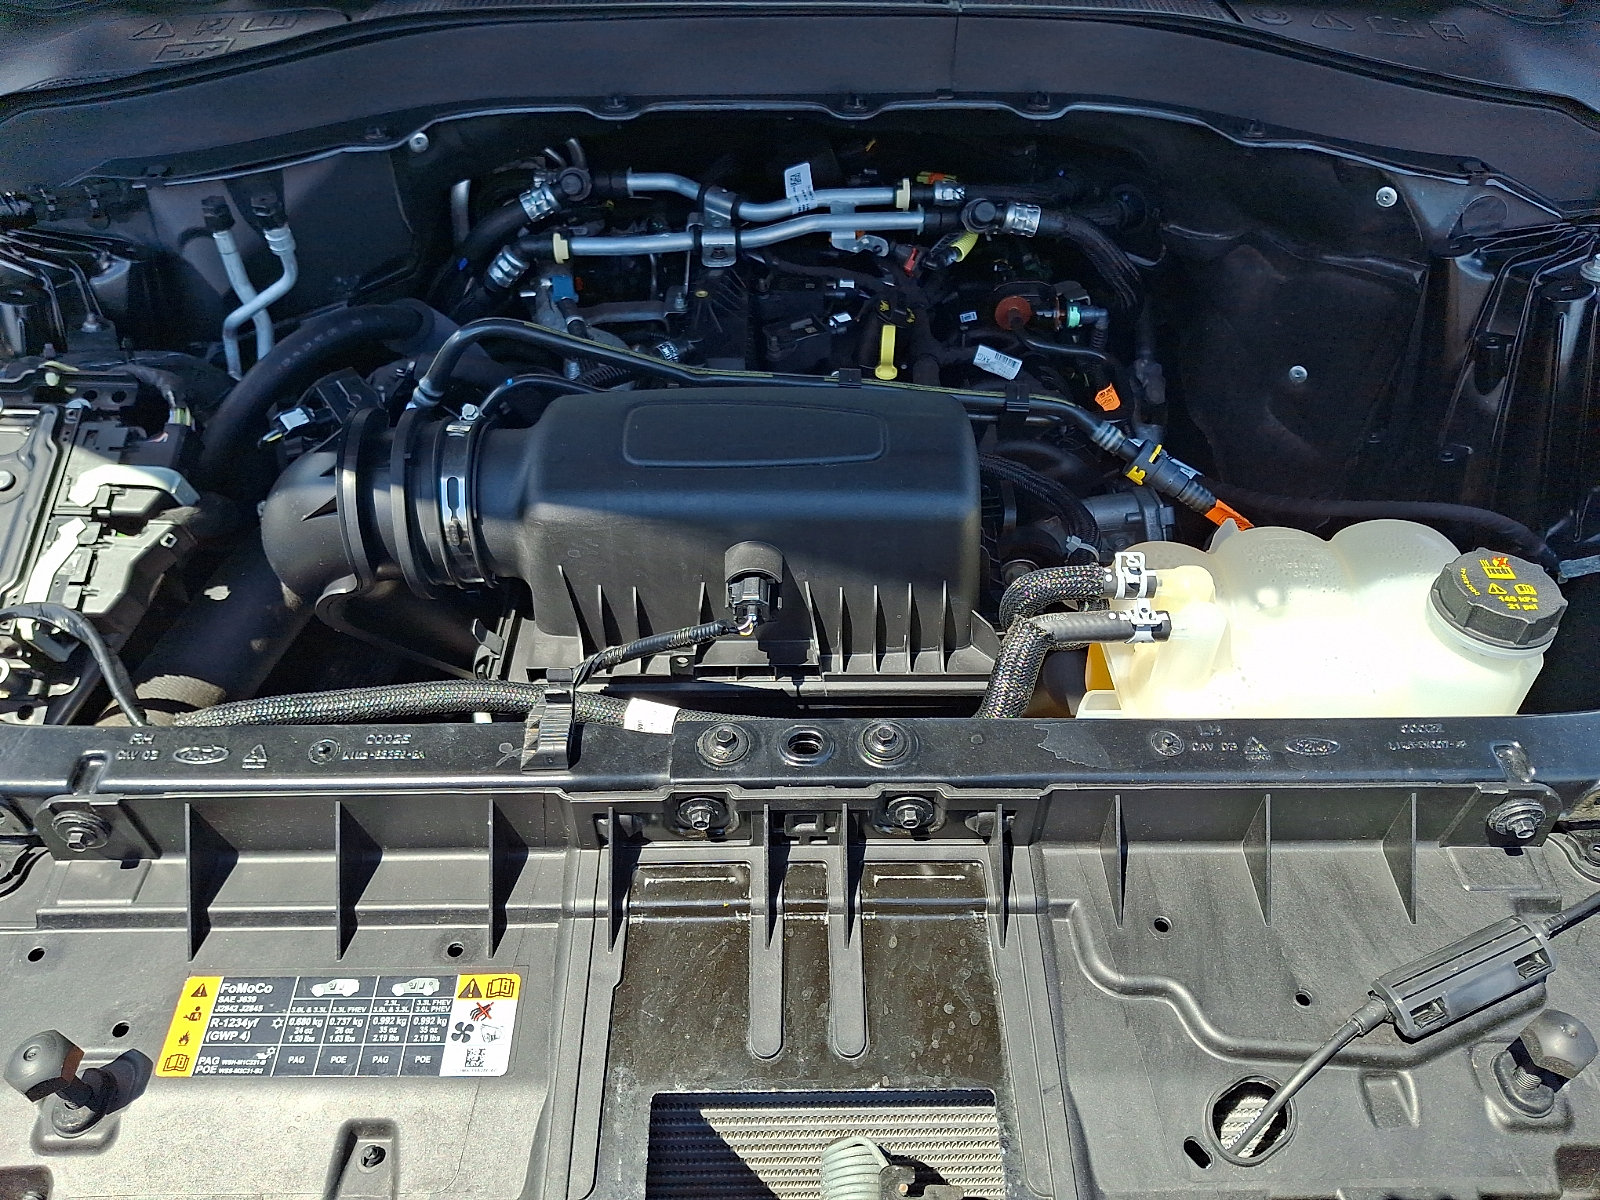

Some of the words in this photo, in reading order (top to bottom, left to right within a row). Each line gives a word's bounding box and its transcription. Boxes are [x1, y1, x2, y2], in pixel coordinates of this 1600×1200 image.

[220, 982, 274, 994] FoMoCo
[217, 995, 237, 1003] SAE
[210, 1017, 260, 1030] R-1234yf
[312, 1017, 324, 1028] kg
[353, 1017, 364, 1028] kg
[373, 1016, 395, 1026] 0.992
[396, 1016, 408, 1027] kg
[413, 1016, 436, 1026] 0.992
[437, 1016, 448, 1027] kg
[379, 1026, 389, 1034] 35
[419, 1026, 429, 1034] 35
[206, 1030, 239, 1043] (GWP
[239, 1030, 251, 1043] 4)
[372, 1034, 388, 1042] 2.19
[389, 1034, 400, 1042] lbs
[413, 1034, 428, 1042] 2.19
[430, 1034, 441, 1042] lbs
[197, 1056, 221, 1065] PAG
[287, 1056, 305, 1064] PAG
[330, 1056, 347, 1064] POE
[372, 1056, 389, 1064] PAG
[414, 1055, 432, 1064] POE
[195, 1065, 218, 1074] POE
